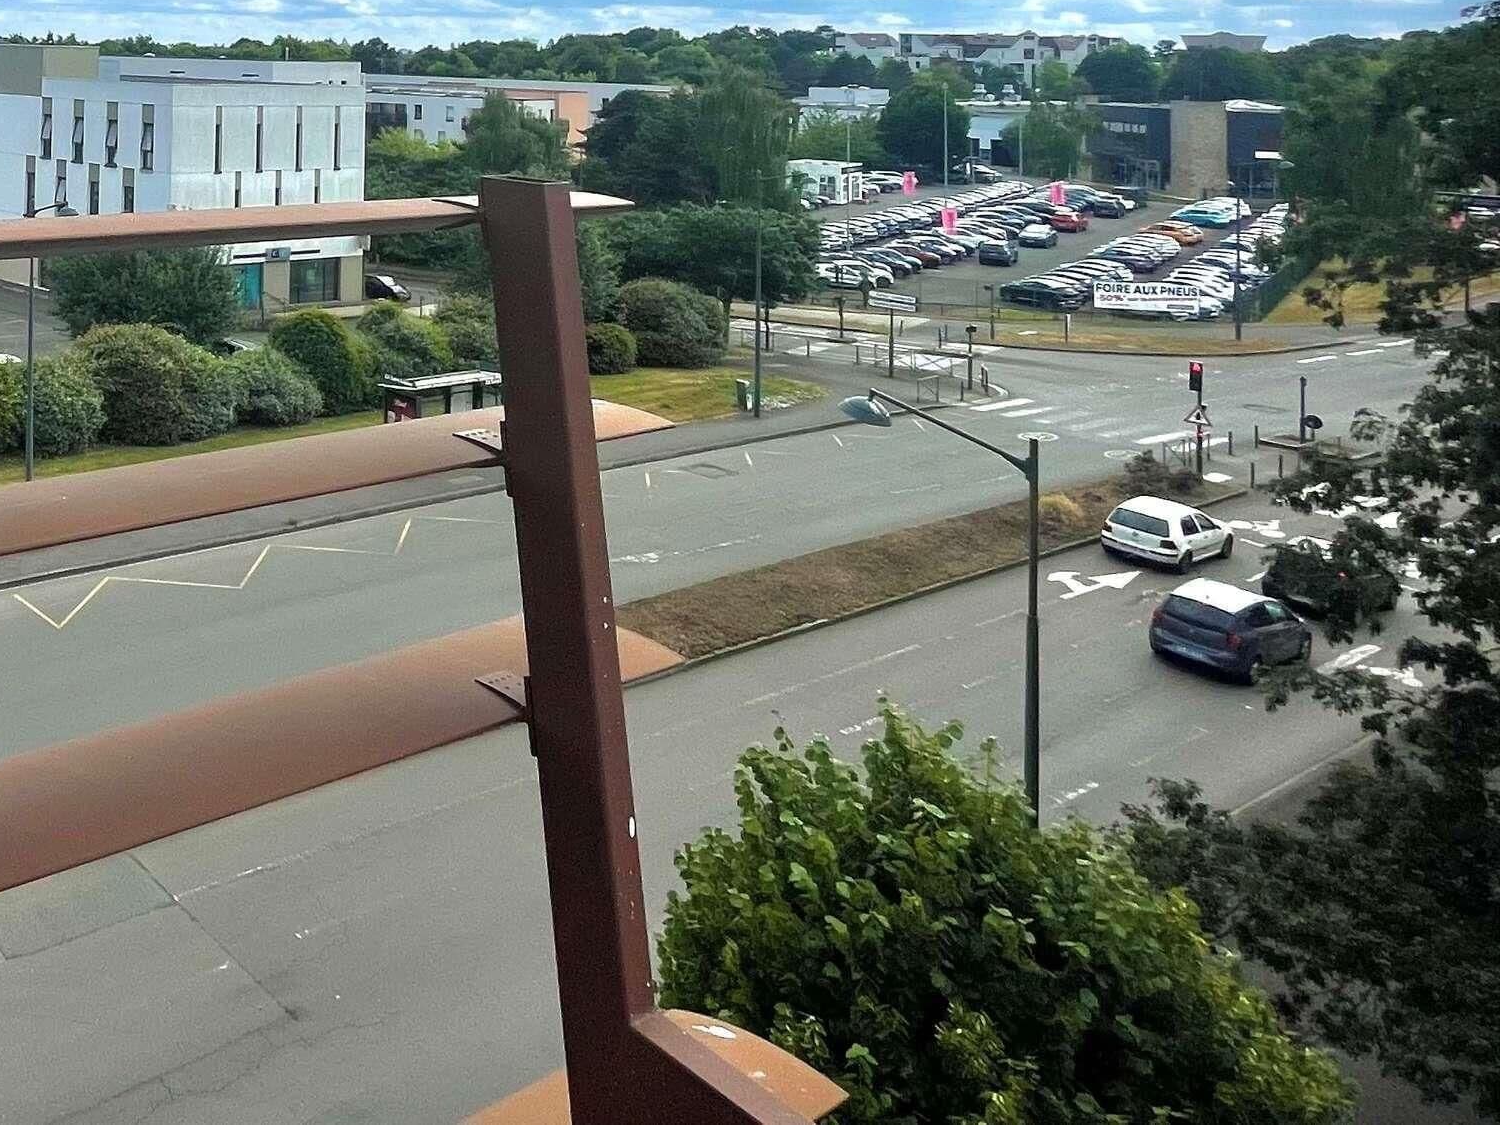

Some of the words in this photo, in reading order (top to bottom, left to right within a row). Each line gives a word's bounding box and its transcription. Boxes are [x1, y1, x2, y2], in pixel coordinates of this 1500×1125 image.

[1095, 283, 1131, 294] FOIRE
[1133, 285, 1158, 295] AUX
[1160, 286, 1198, 297] PNEUS
